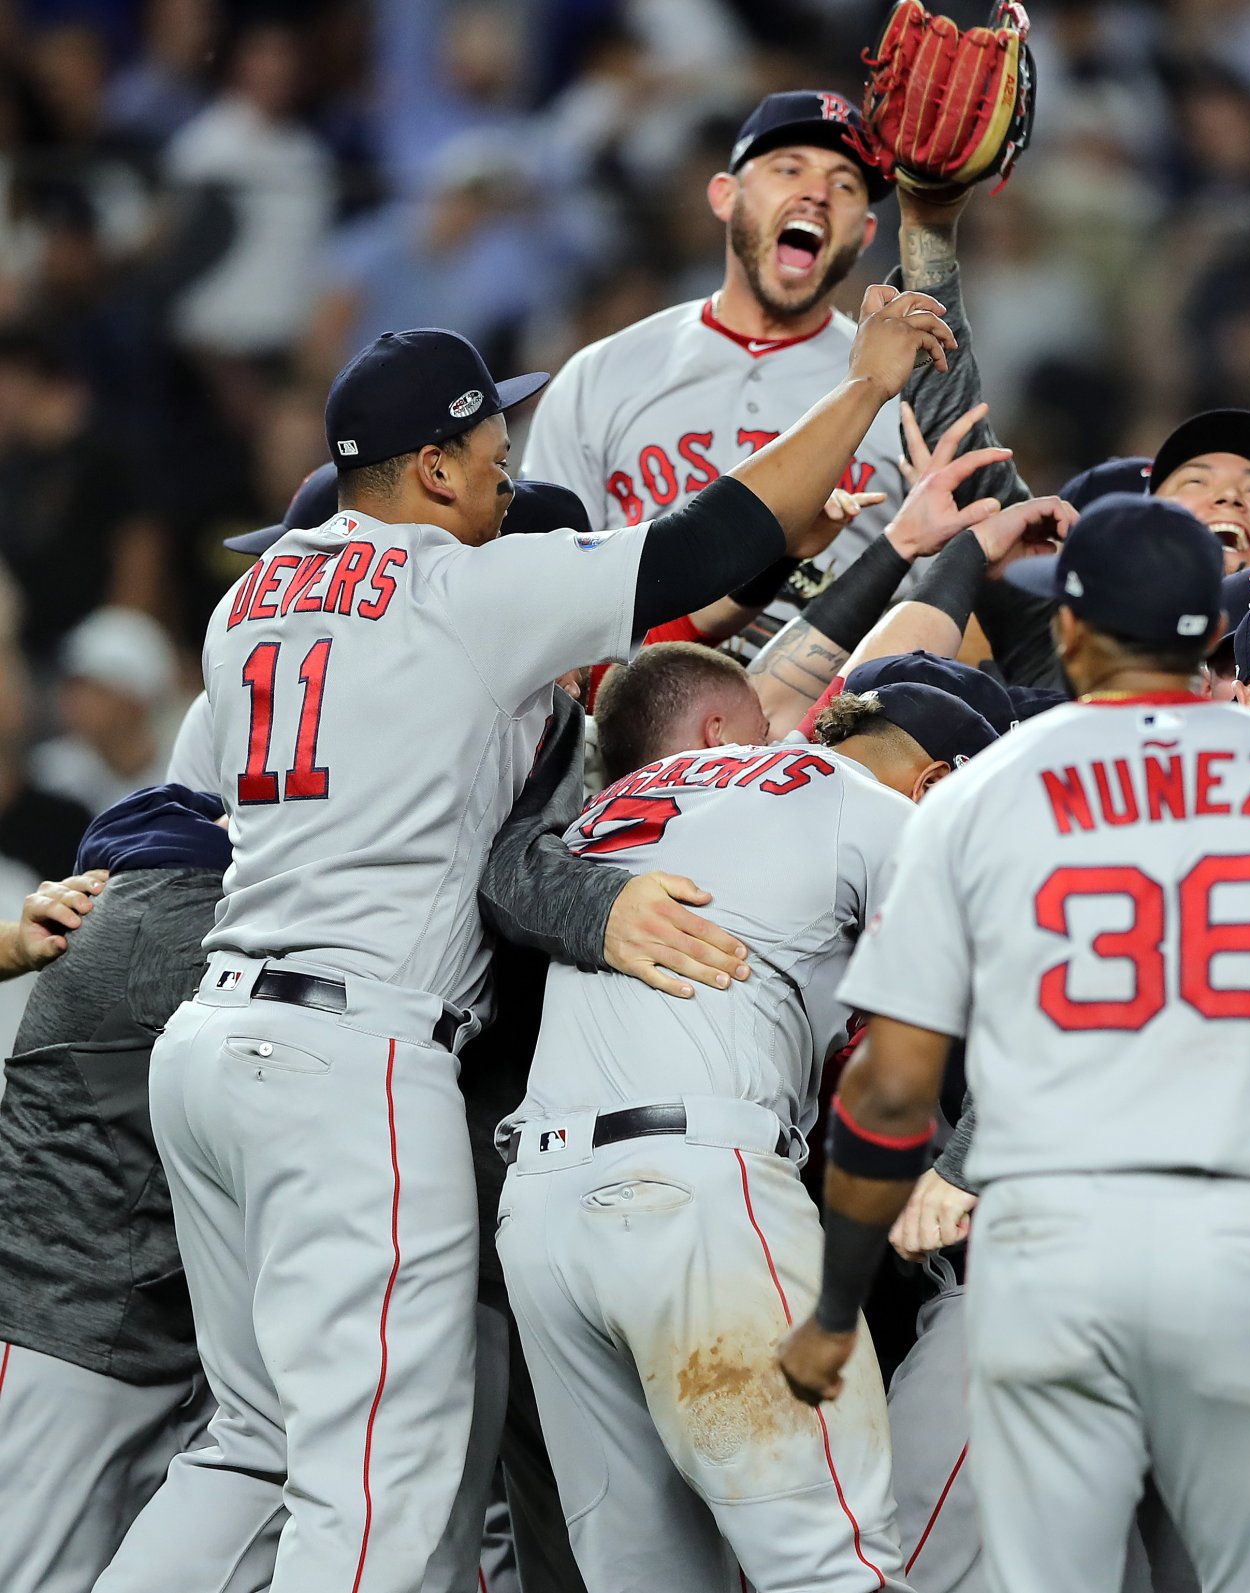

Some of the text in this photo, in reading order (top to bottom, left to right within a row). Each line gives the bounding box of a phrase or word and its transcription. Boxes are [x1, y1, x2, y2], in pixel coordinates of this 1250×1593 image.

[606, 428, 876, 527] BOSTN
[227, 541, 408, 633] DEVERS
[238, 637, 329, 805] 11
